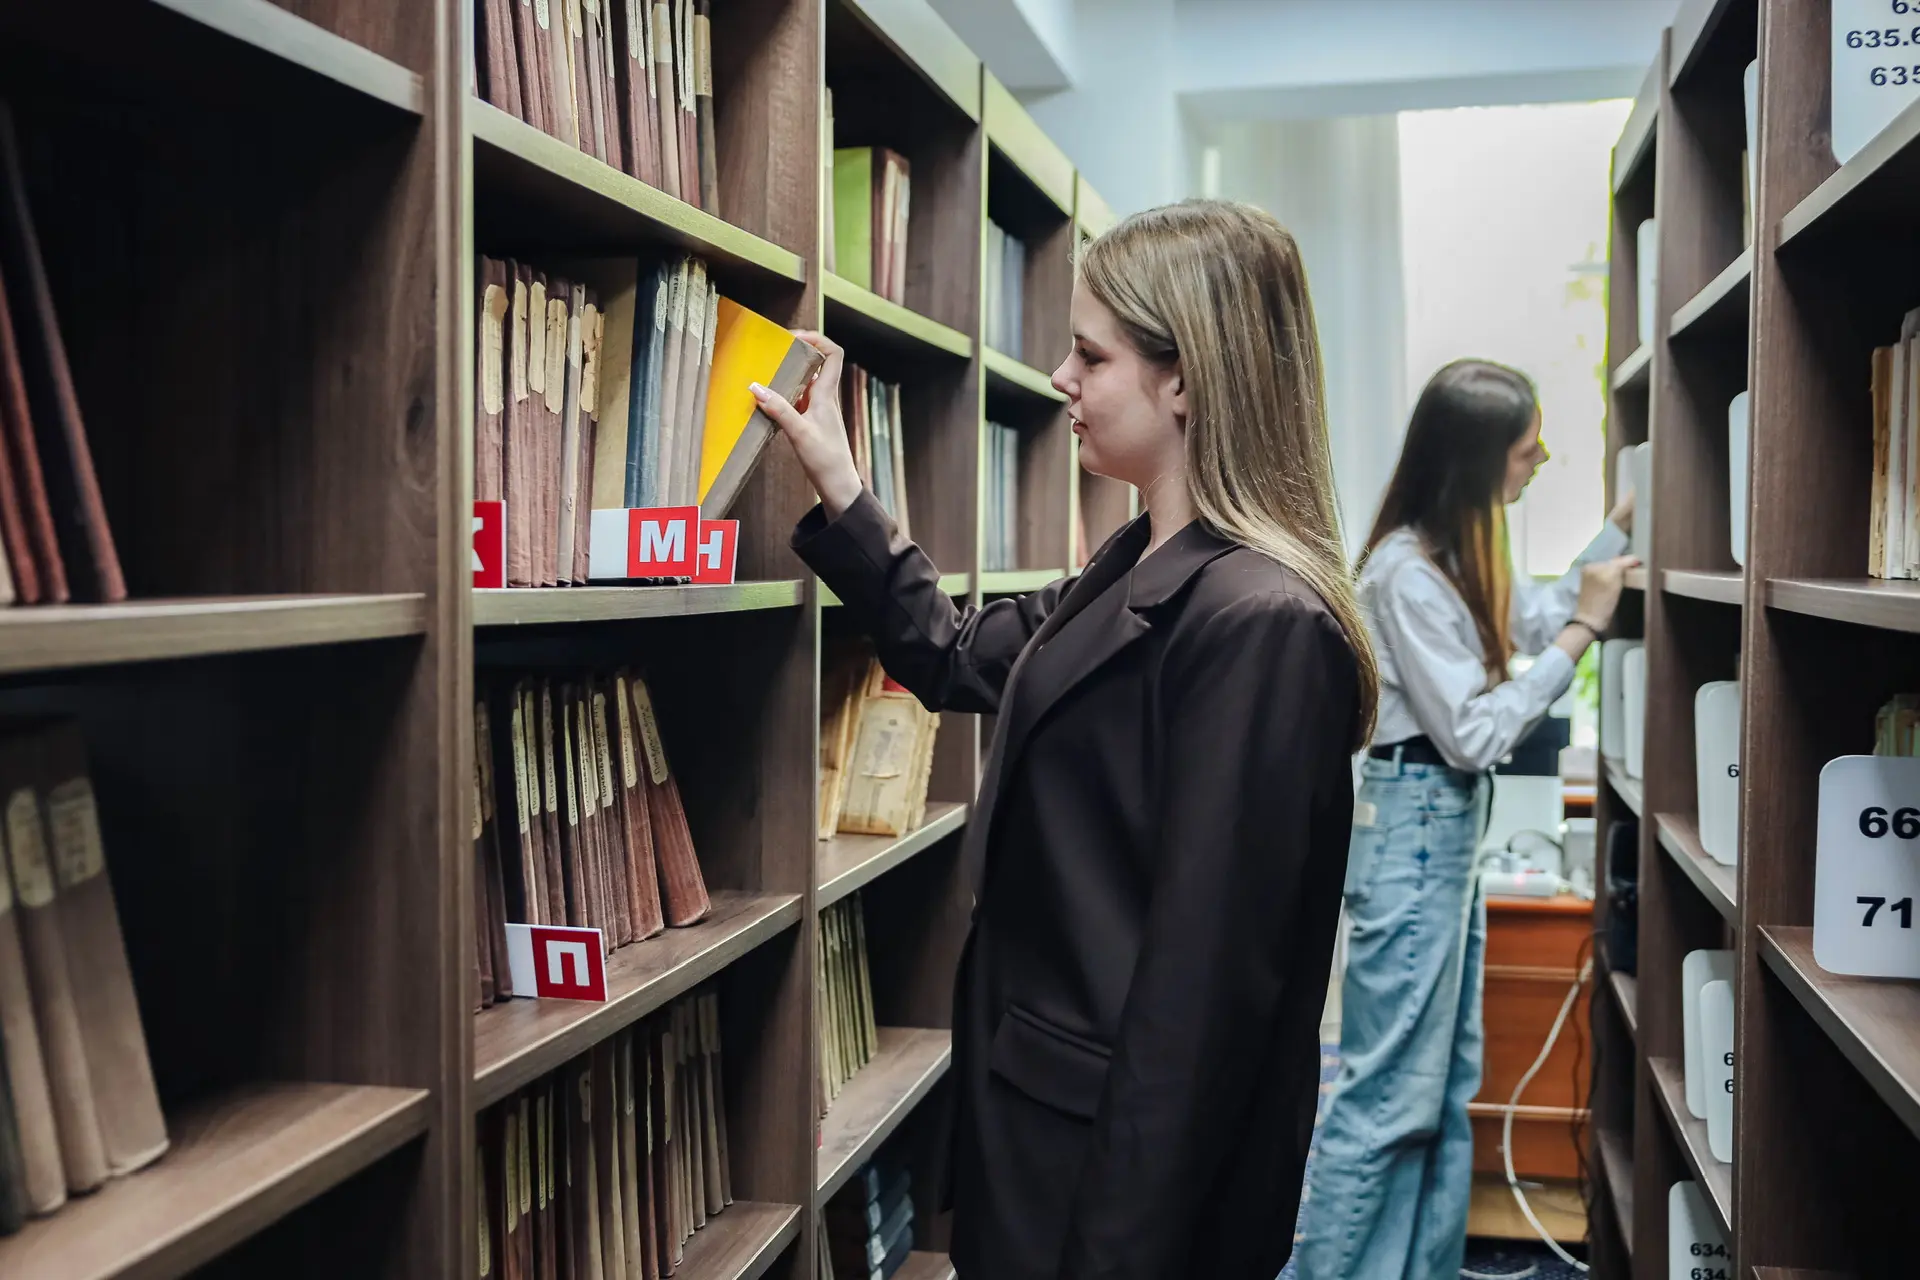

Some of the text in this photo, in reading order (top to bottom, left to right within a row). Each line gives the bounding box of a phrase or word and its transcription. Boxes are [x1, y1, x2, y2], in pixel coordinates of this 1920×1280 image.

[639, 519, 686, 563] М
[1858, 806, 1920, 839] 66
[1857, 896, 1912, 928] 71
[545, 940, 590, 986] П
